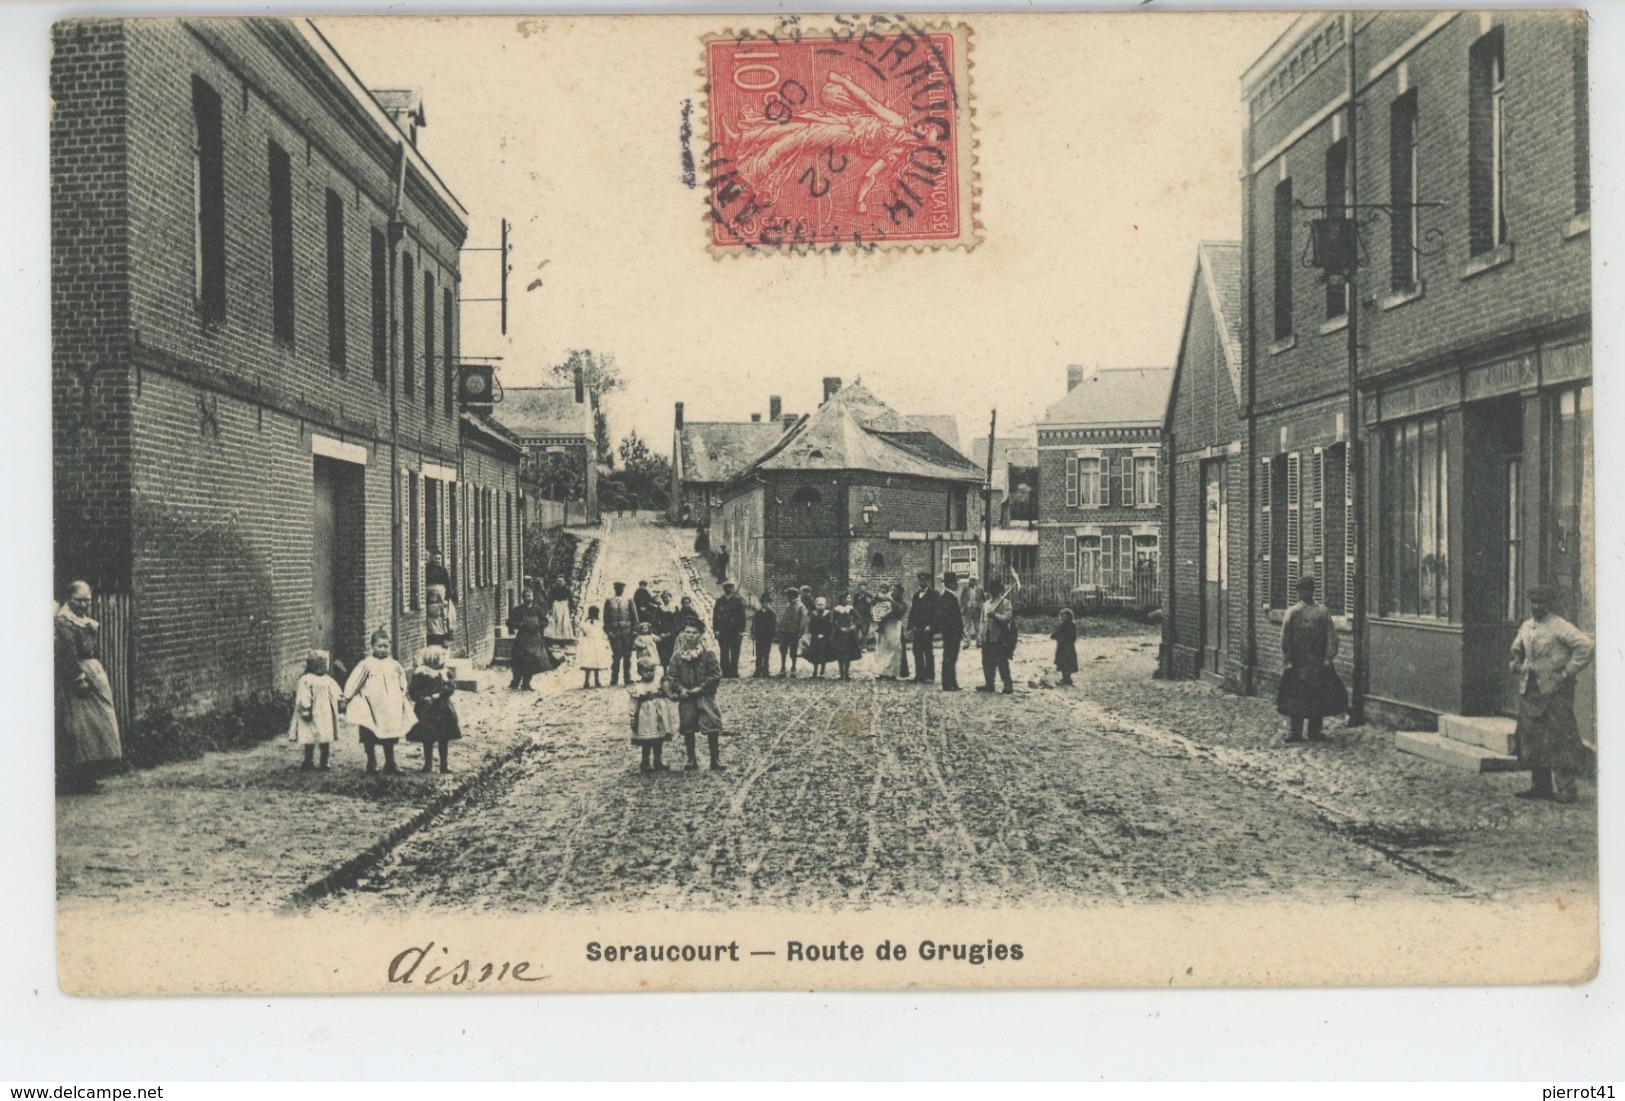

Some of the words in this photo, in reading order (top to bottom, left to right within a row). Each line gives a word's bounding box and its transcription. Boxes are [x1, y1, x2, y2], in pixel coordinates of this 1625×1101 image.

[830, 13, 951, 227] SERAUCOUR
[797, 146, 848, 198] 22
[586, 940, 740, 962] Seraucourt
[787, 940, 864, 962] Route
[875, 939, 907, 961] de
[918, 939, 1024, 967] Grugies
